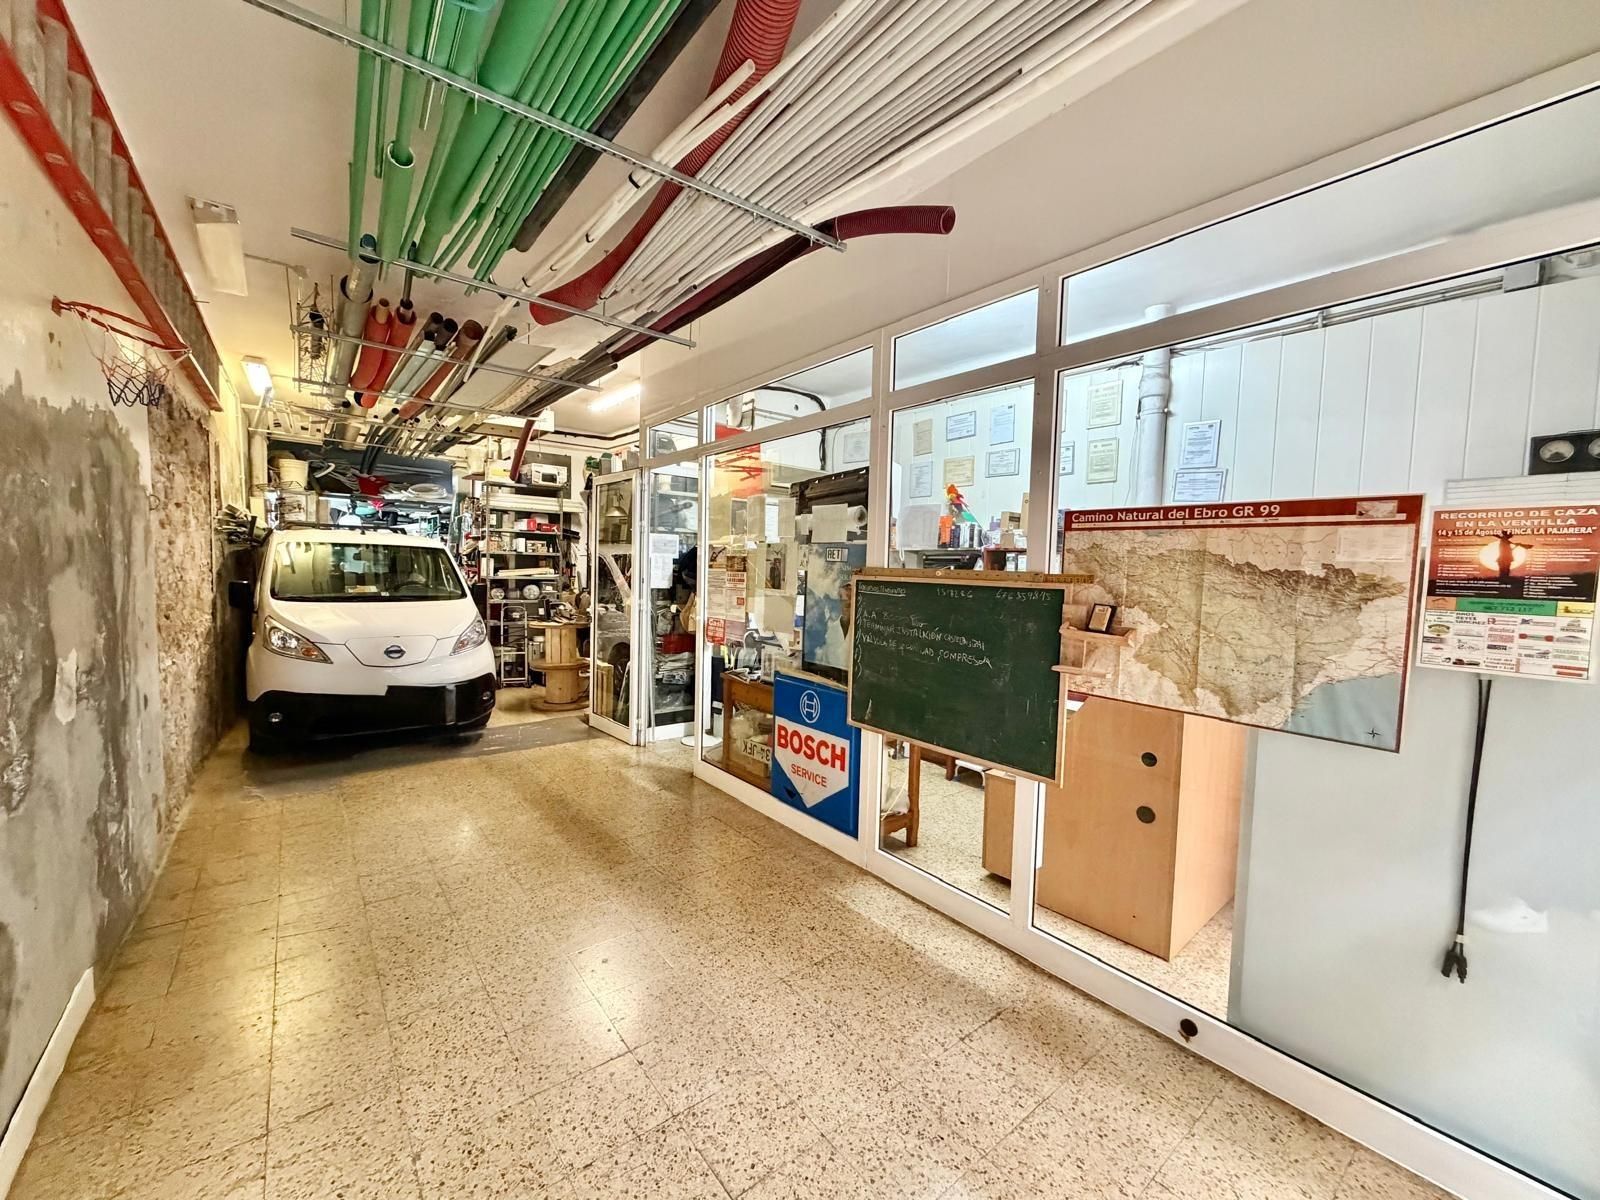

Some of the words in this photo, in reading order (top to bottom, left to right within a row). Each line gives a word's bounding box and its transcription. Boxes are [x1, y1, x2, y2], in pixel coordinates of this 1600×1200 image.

[1071, 512, 1114, 523] Camino
[1117, 509, 1164, 522] Natural
[1168, 508, 1190, 520] del
[1194, 507, 1227, 519] Ebro
[1231, 506, 1255, 518] GR
[1259, 505, 1281, 517] 99
[1440, 511, 1525, 520] RECORRIDO
[1528, 509, 1551, 518] DE
[1554, 508, 1598, 516] CAZA
[1455, 520, 1475, 528] EN
[1477, 519, 1496, 528] LA
[1502, 518, 1577, 527] VENTILLA
[777, 724, 846, 772] BOSCH
[790, 763, 828, 788] SERVICE
